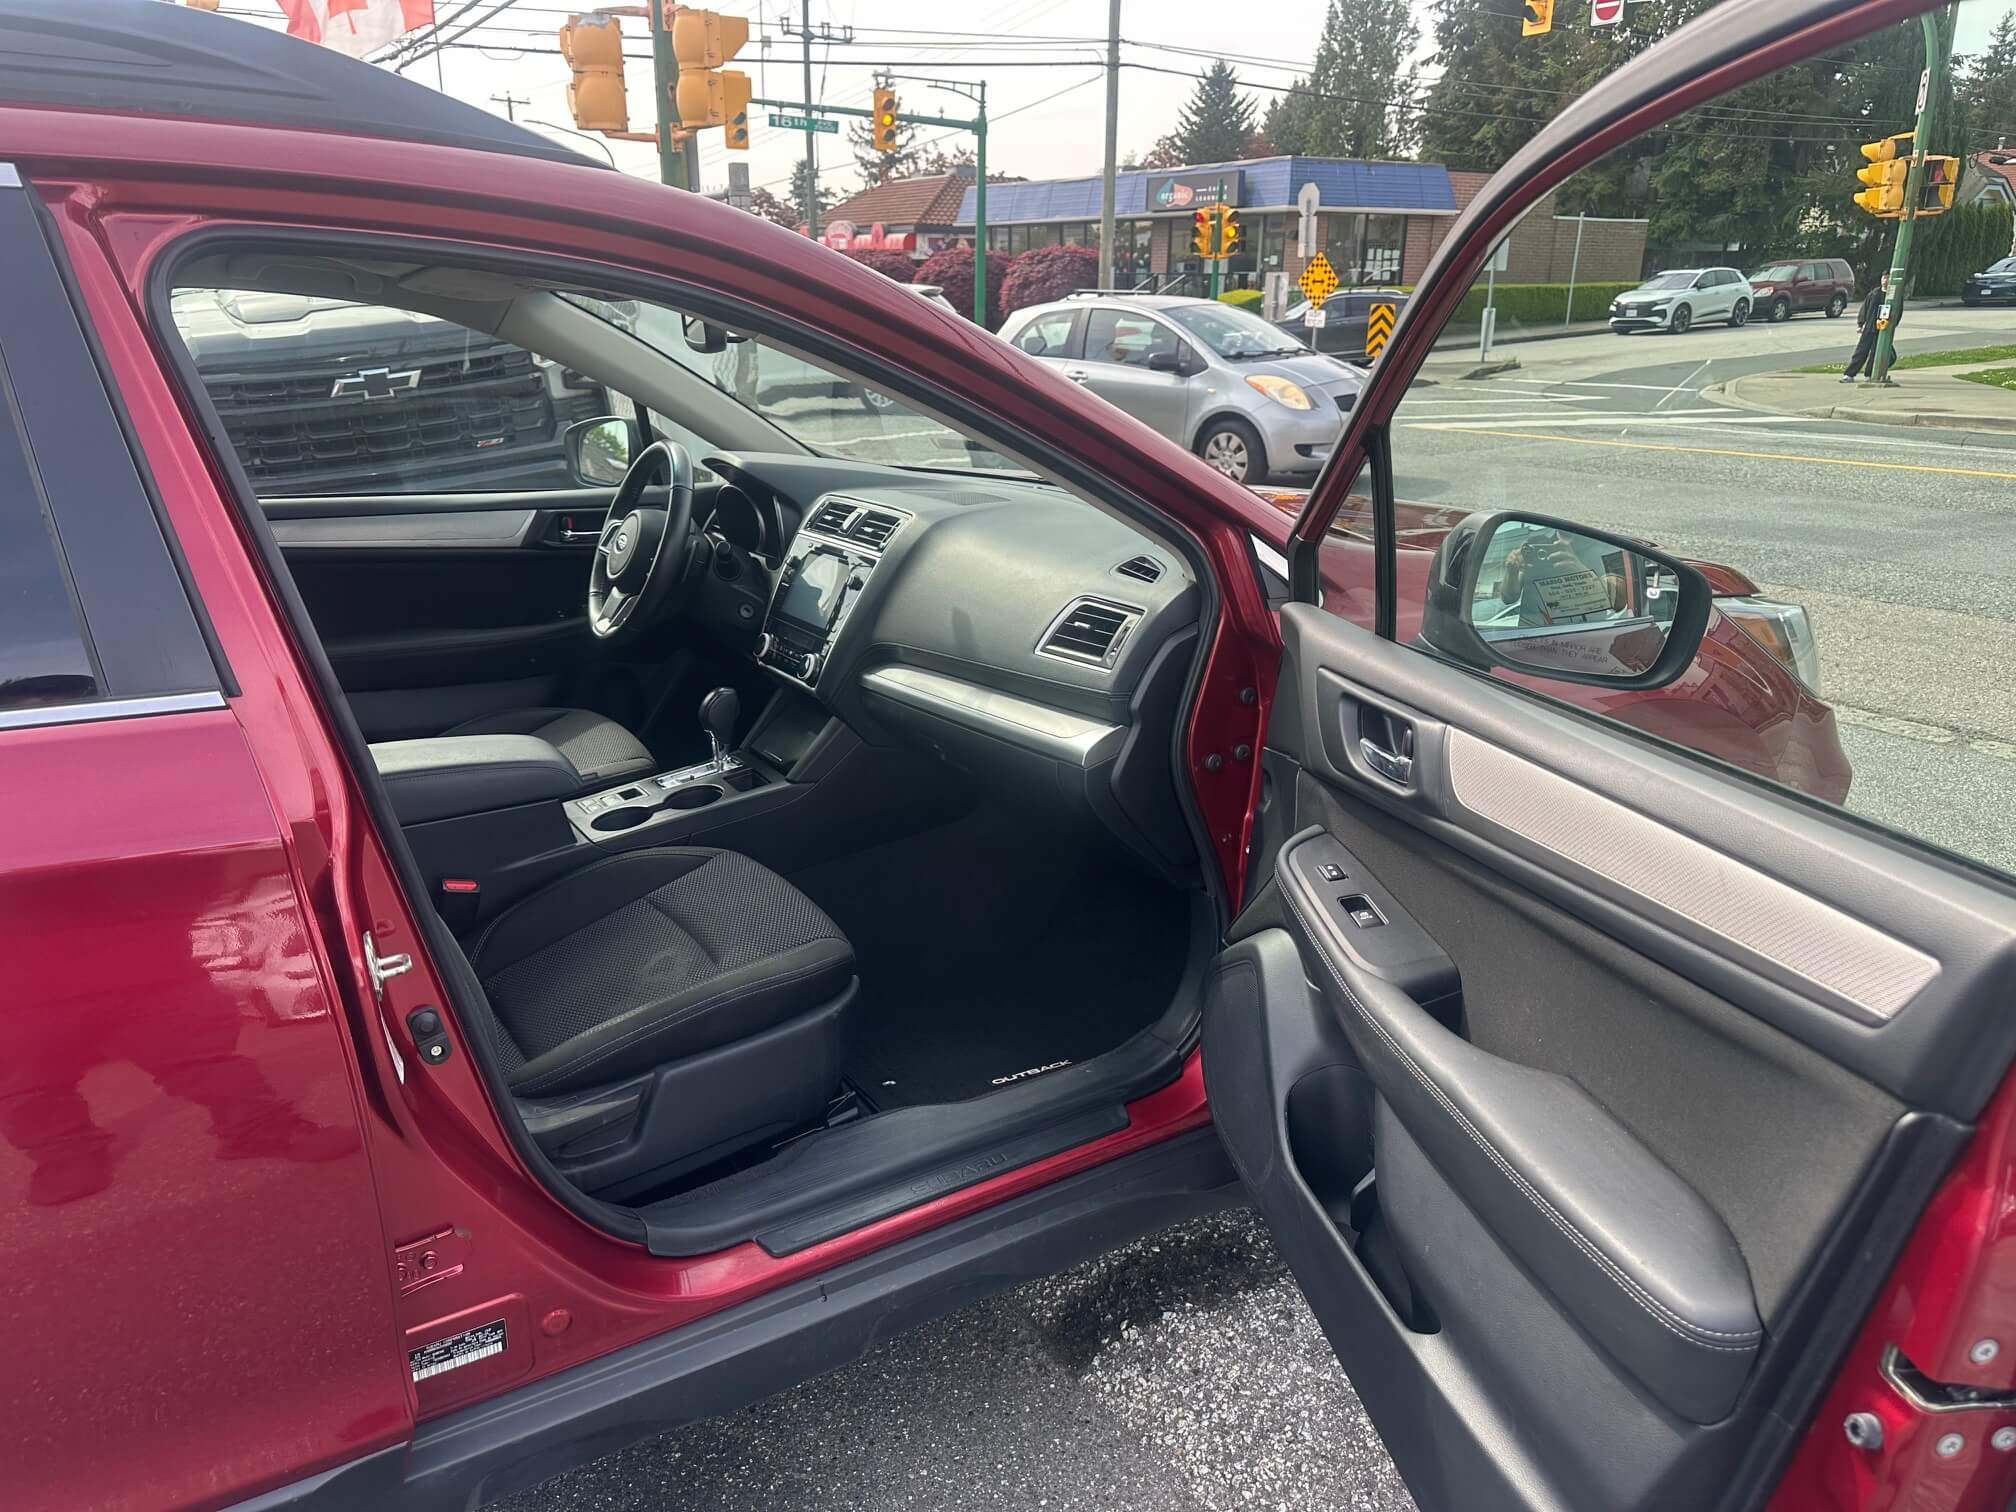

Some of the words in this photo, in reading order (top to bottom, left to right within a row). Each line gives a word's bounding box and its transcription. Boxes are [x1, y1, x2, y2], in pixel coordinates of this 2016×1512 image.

[772, 116, 807, 127] 16th
[1160, 191, 1188, 202] organic
[991, 1059, 1073, 1085] OUTBACK
